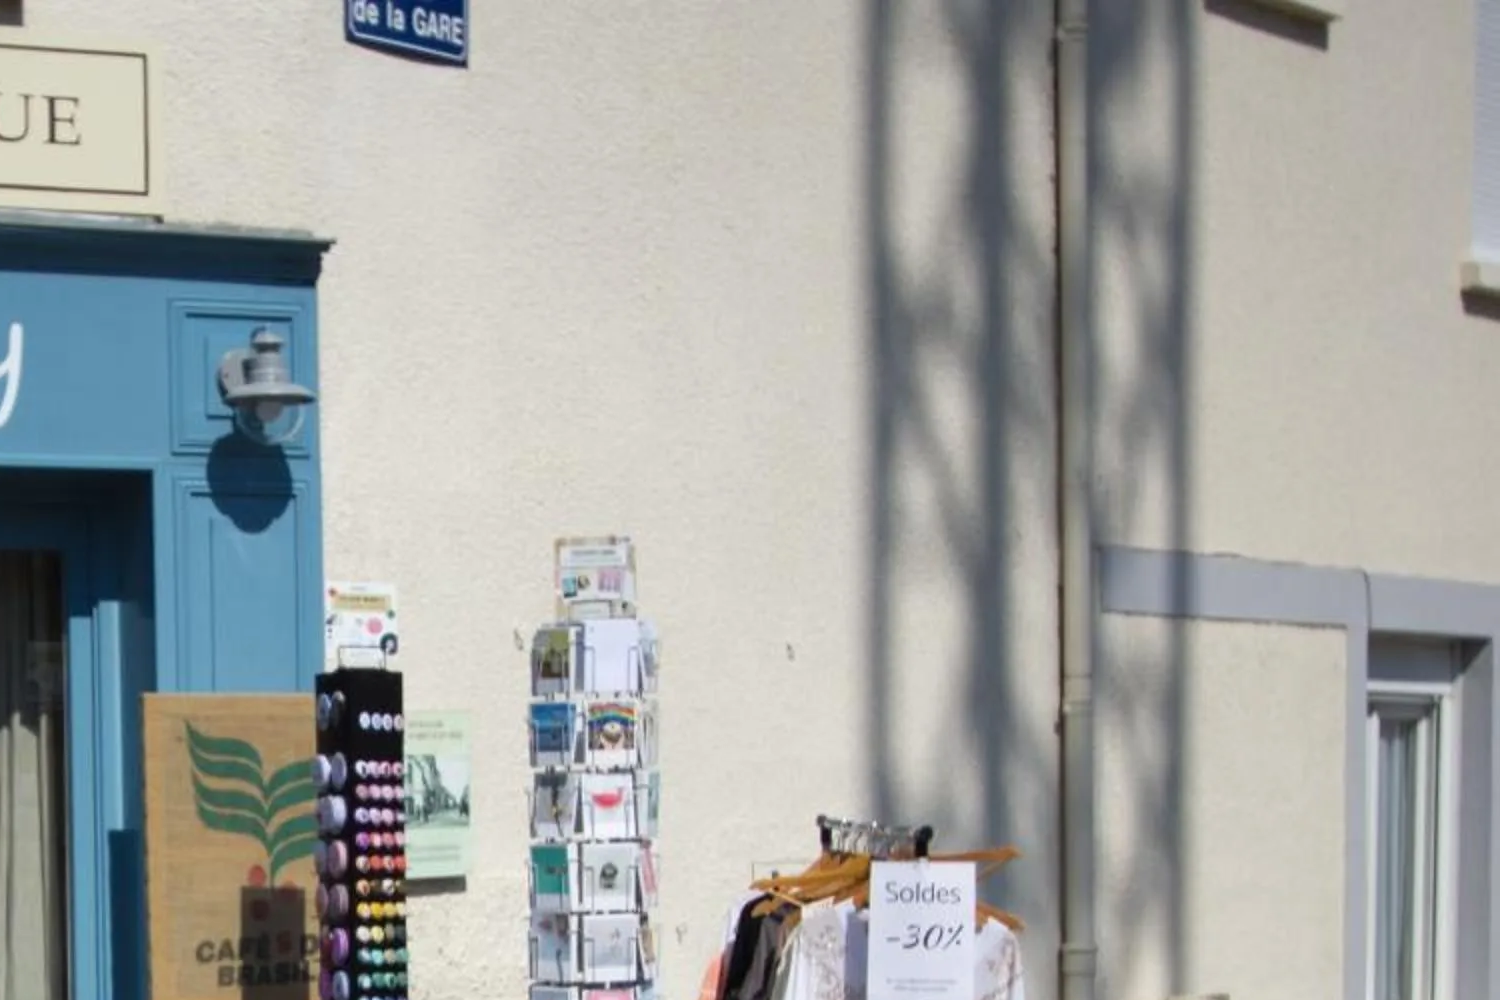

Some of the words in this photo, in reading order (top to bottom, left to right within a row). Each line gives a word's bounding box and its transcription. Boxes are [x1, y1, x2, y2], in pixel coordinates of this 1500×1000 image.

[353, 0, 380, 25] de
[386, 1, 406, 31] la
[412, 7, 464, 45] GARE
[885, 880, 962, 904] Soldes
[886, 923, 964, 951] -30%
